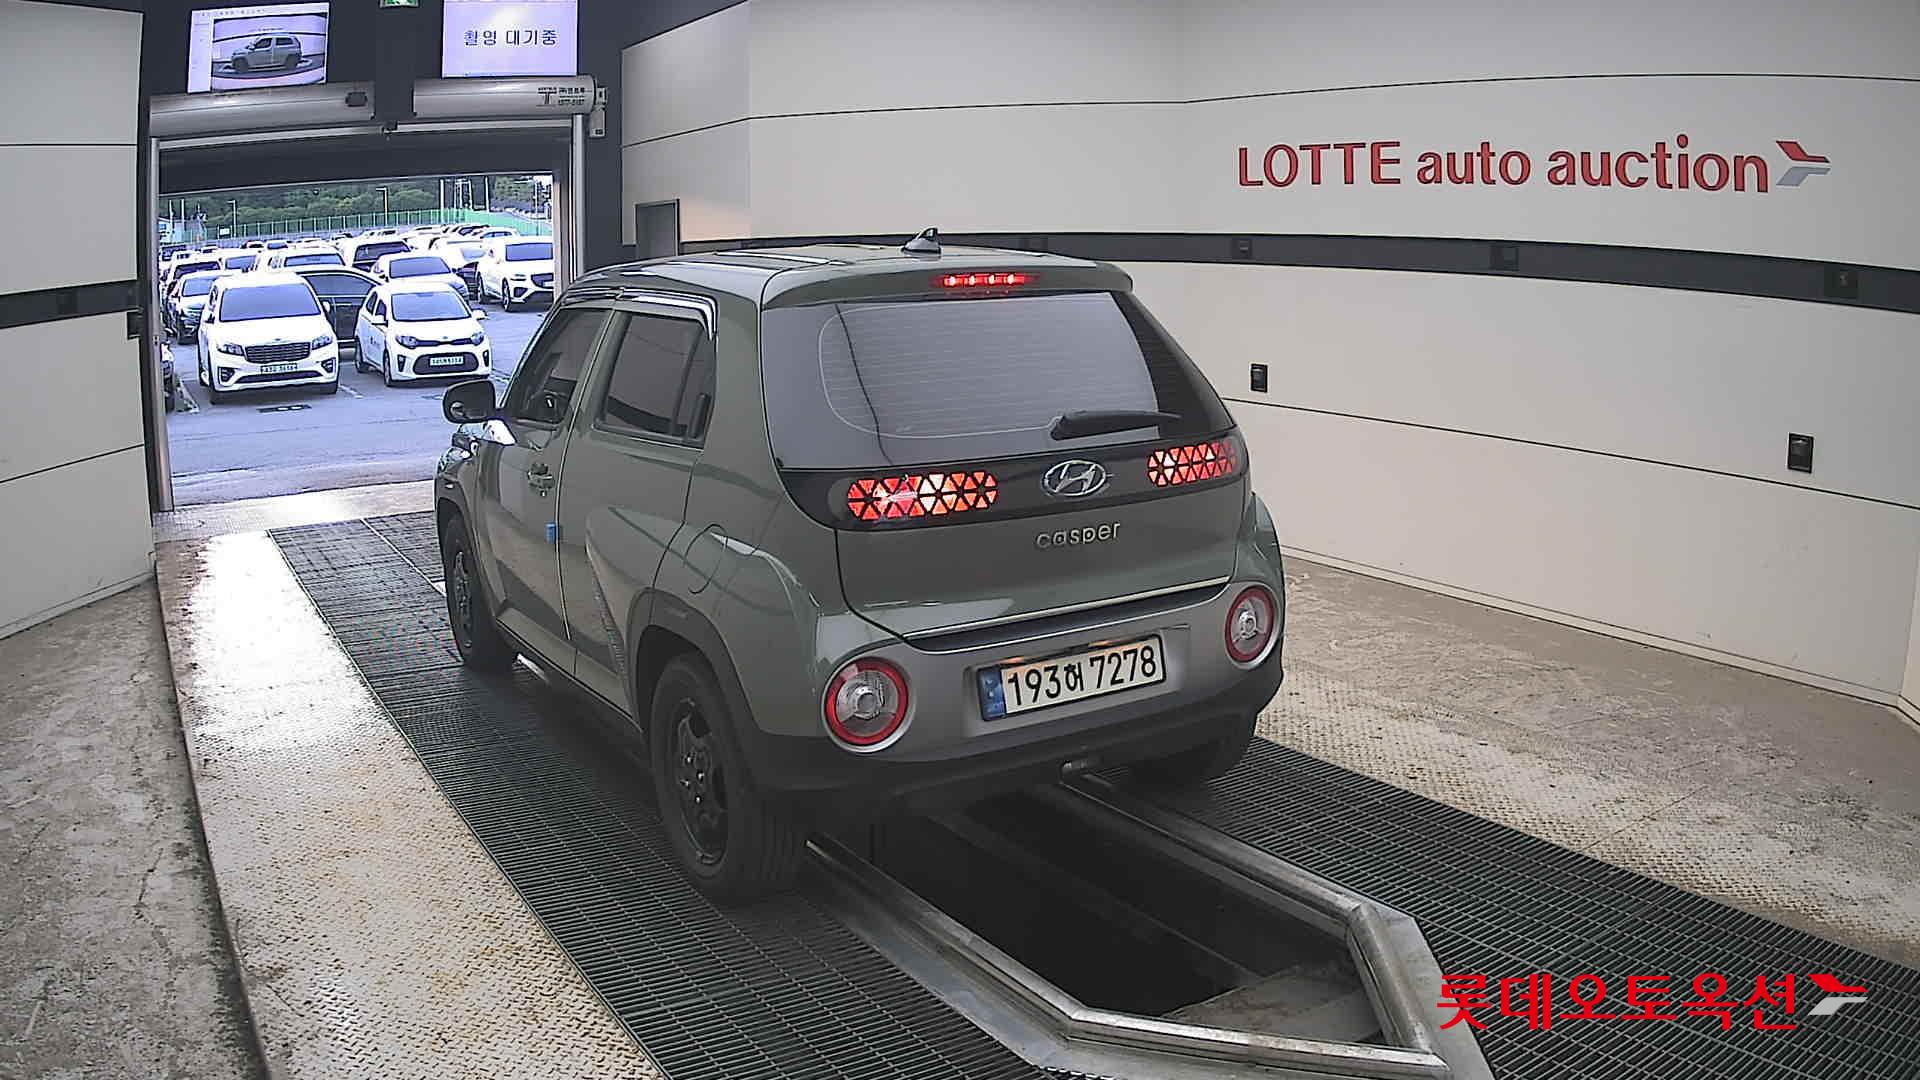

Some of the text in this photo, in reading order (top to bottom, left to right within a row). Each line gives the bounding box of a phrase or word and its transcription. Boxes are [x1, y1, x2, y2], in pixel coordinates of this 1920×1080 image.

[505, 29, 558, 46] 대기중
[1238, 133, 1769, 194] LOTTE auto auction
[1036, 521, 1121, 548] casper
[1089, 645, 1157, 689] 7278
